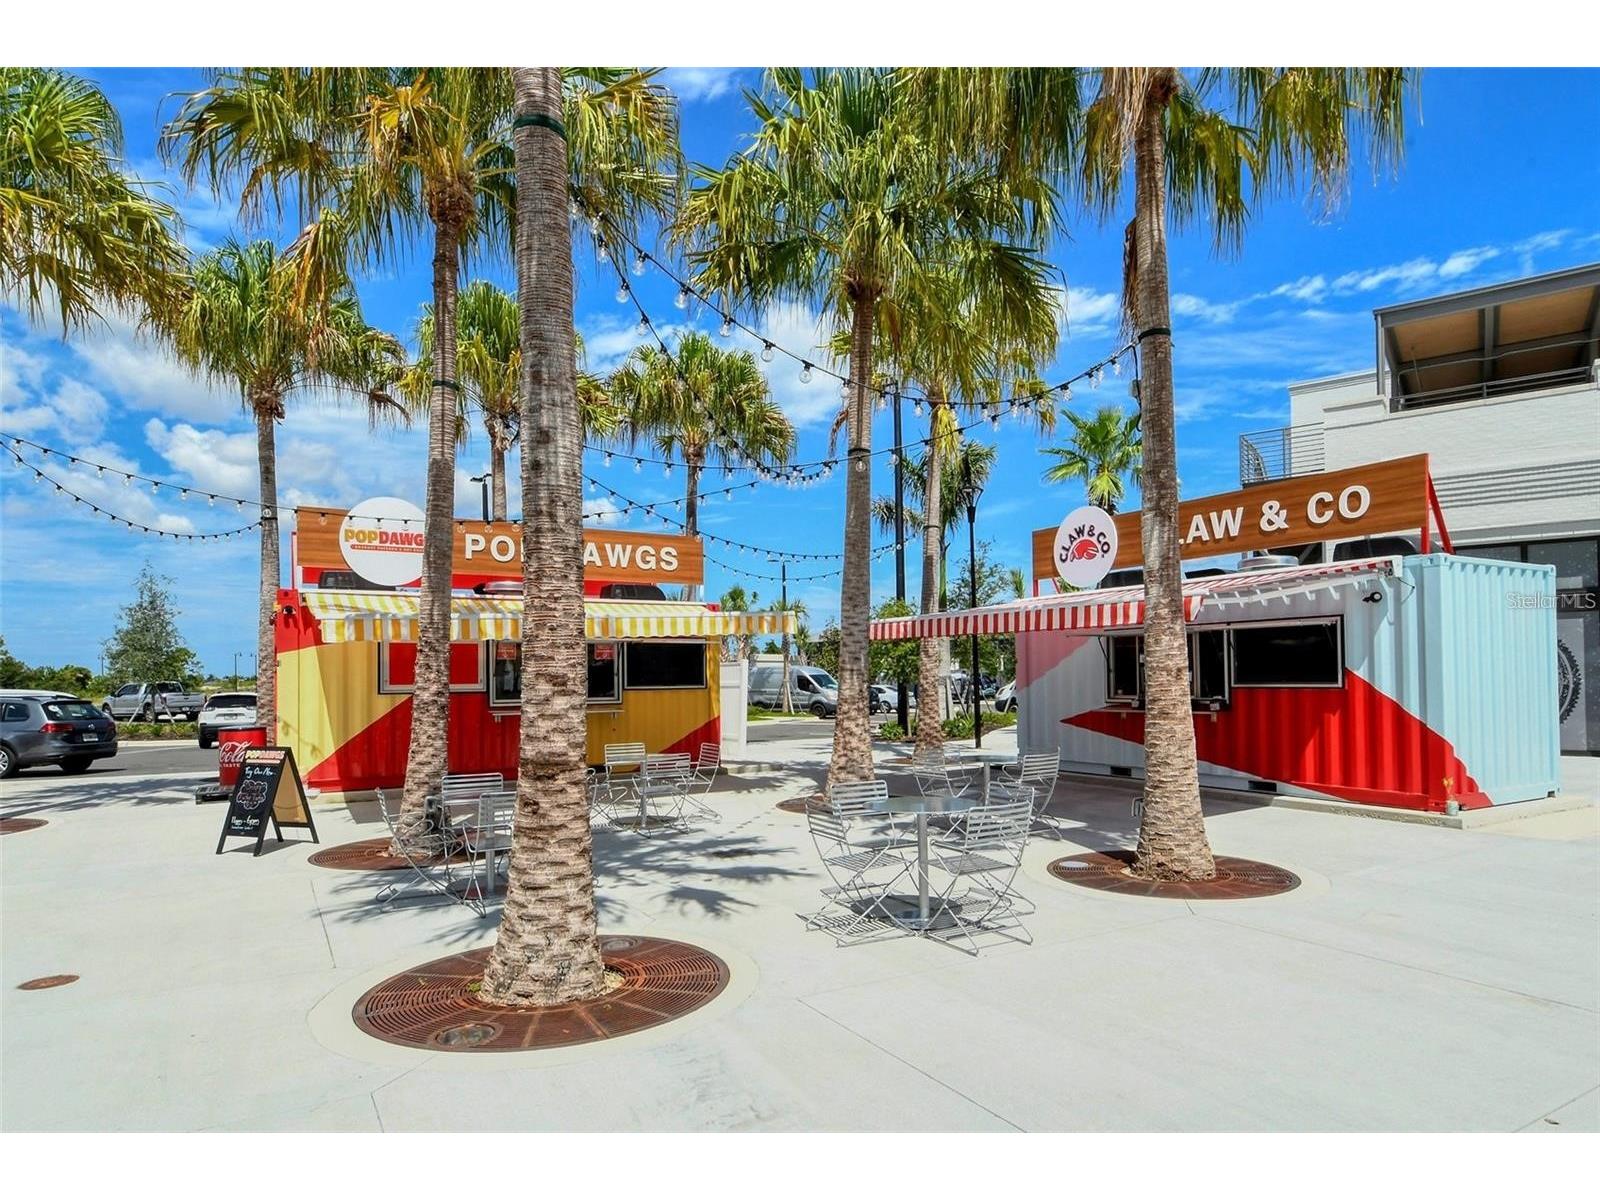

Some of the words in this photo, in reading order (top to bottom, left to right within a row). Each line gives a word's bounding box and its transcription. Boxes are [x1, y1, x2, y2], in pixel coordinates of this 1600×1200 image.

[1178, 507, 1244, 544] AW
[1259, 500, 1289, 532] &
[1306, 485, 1371, 524] CO
[344, 528, 425, 546] POPDAWG
